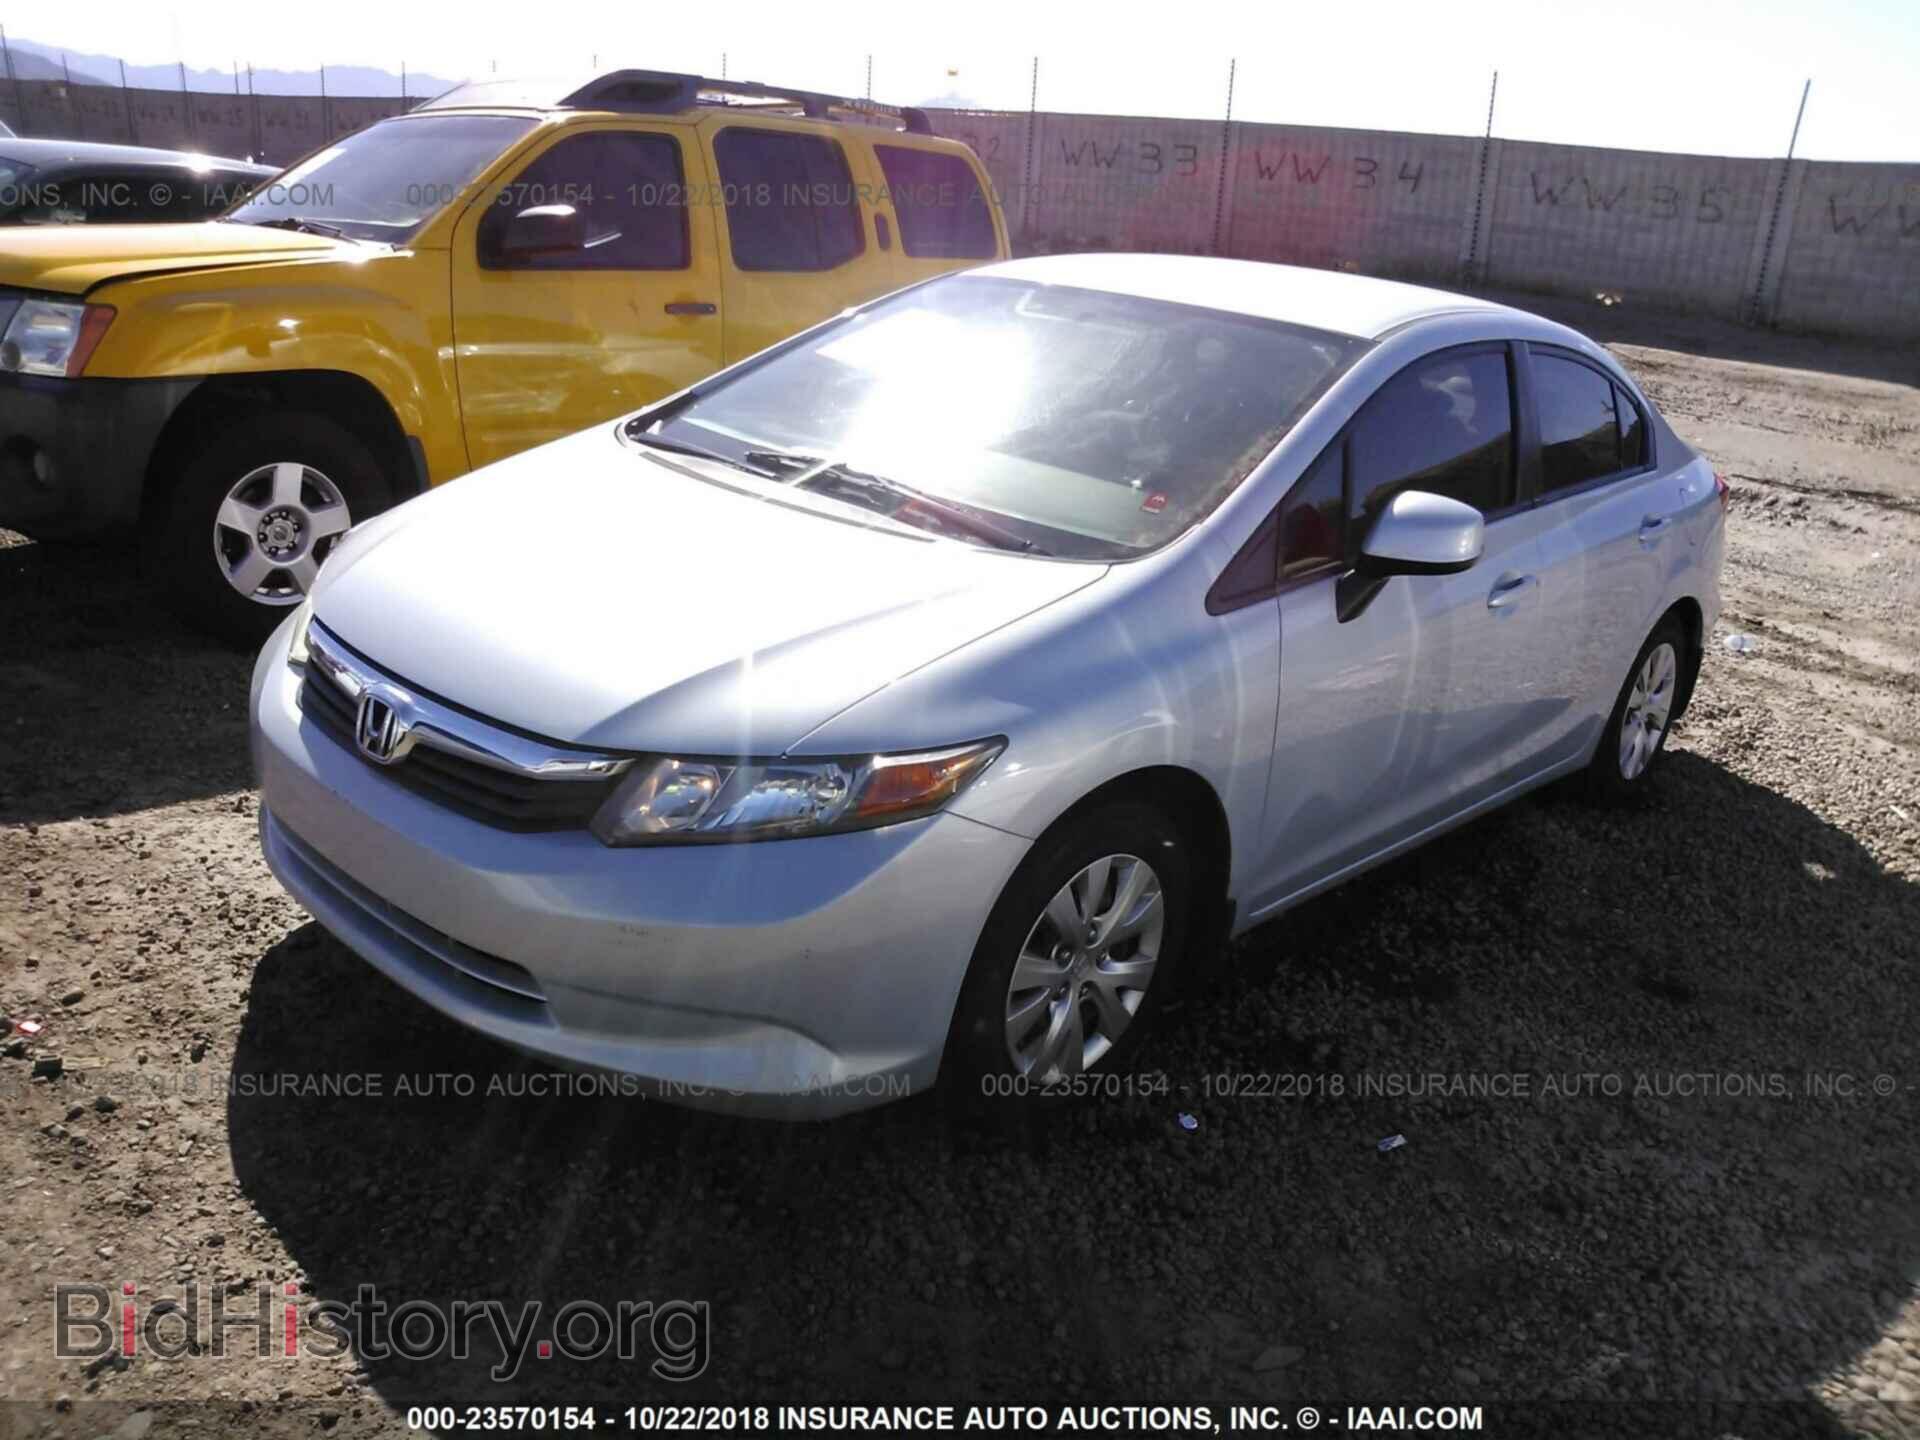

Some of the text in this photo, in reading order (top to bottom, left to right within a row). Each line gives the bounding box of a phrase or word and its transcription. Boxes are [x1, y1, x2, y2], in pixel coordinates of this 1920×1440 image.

[1061, 136, 1199, 177] WW 33
[1254, 150, 1425, 194] WW 34
[1530, 169, 1728, 226] WW 35
